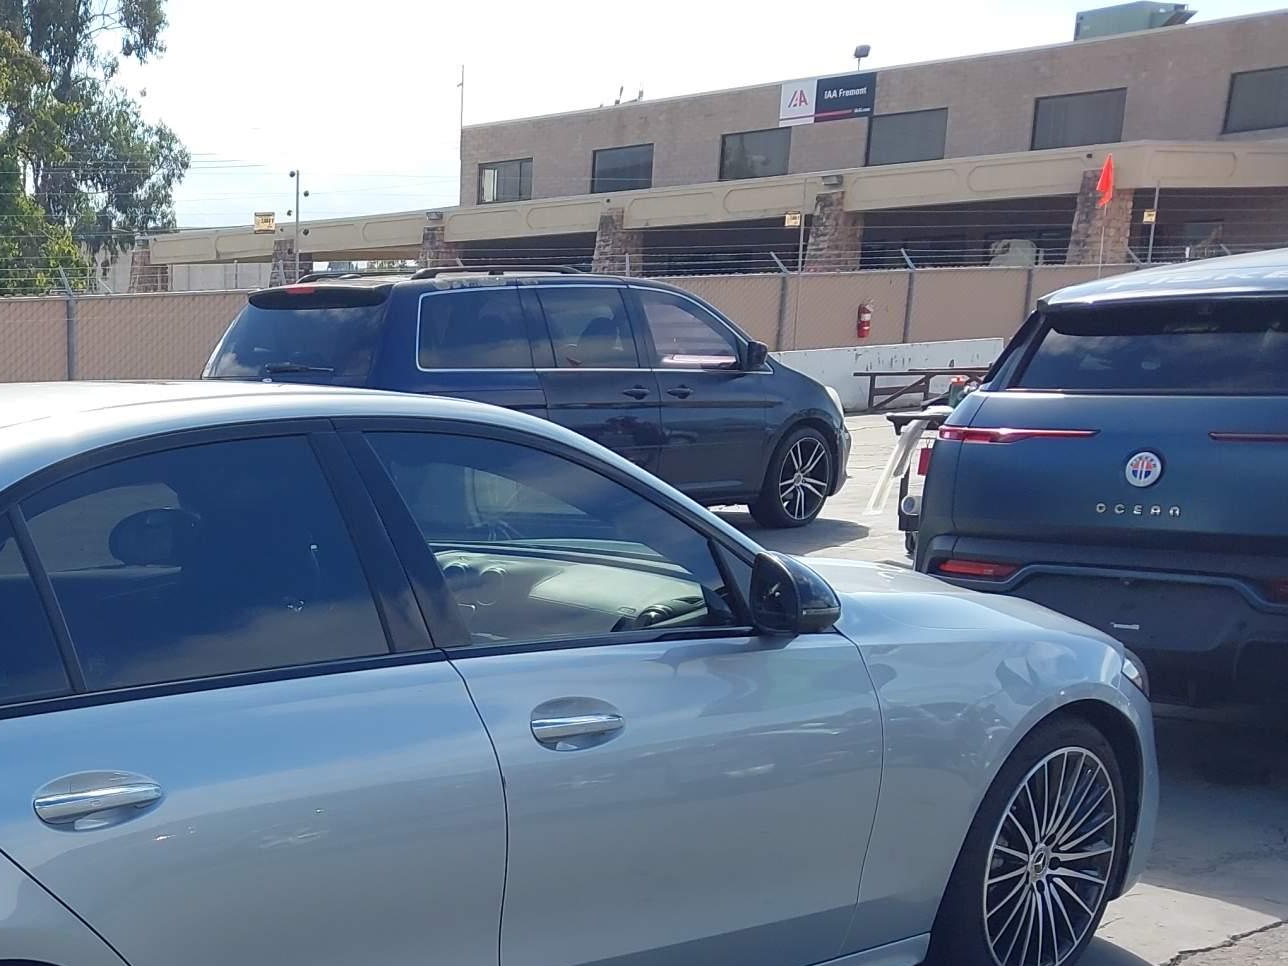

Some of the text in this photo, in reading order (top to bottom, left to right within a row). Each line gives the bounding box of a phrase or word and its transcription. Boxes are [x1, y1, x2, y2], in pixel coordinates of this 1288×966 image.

[824, 87, 867, 99] IAA Fremont
[1096, 503, 1181, 517] OCEAN
